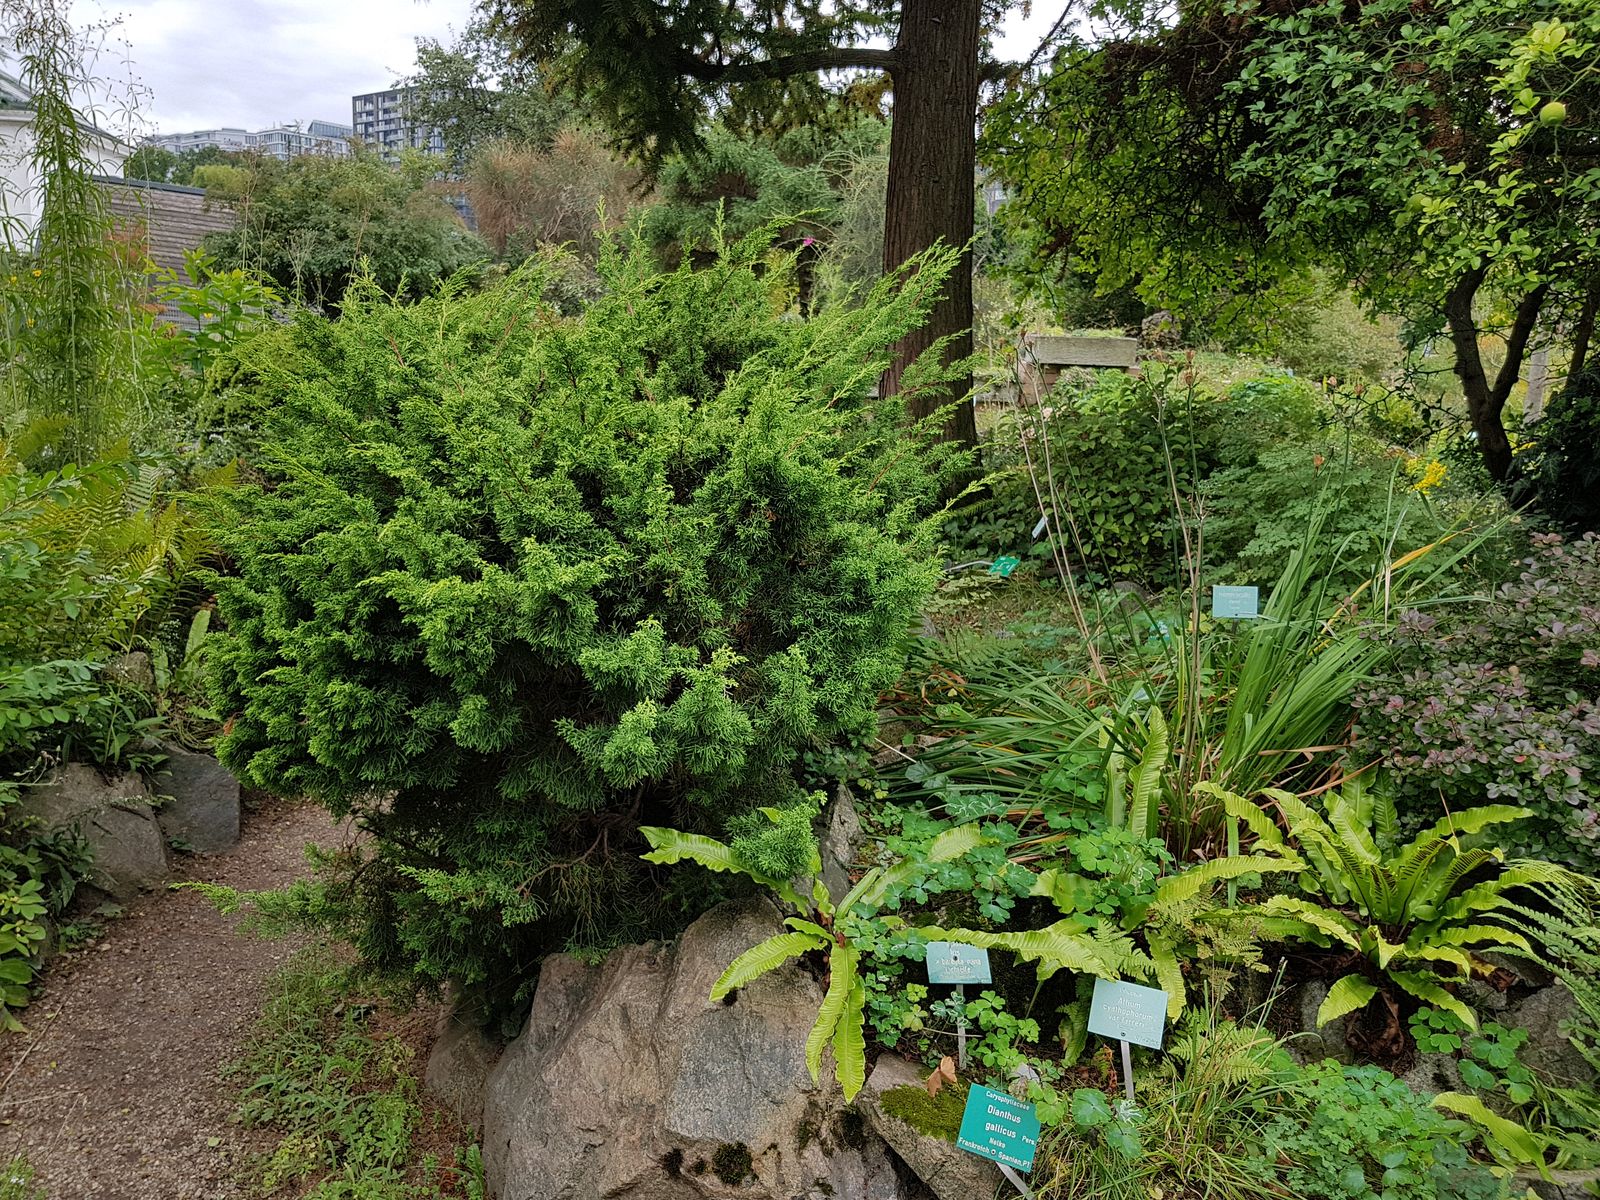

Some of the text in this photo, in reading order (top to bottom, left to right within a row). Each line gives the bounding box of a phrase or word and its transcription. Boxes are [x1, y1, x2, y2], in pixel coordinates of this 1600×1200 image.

[985, 1090, 1031, 1111] Caryophyllaceae
[987, 1104, 1022, 1124] Dianthus
[984, 1122, 1017, 1139] gallicus
[958, 1136, 990, 1154] Frankreich
[988, 1137, 1006, 1149] Nelke
